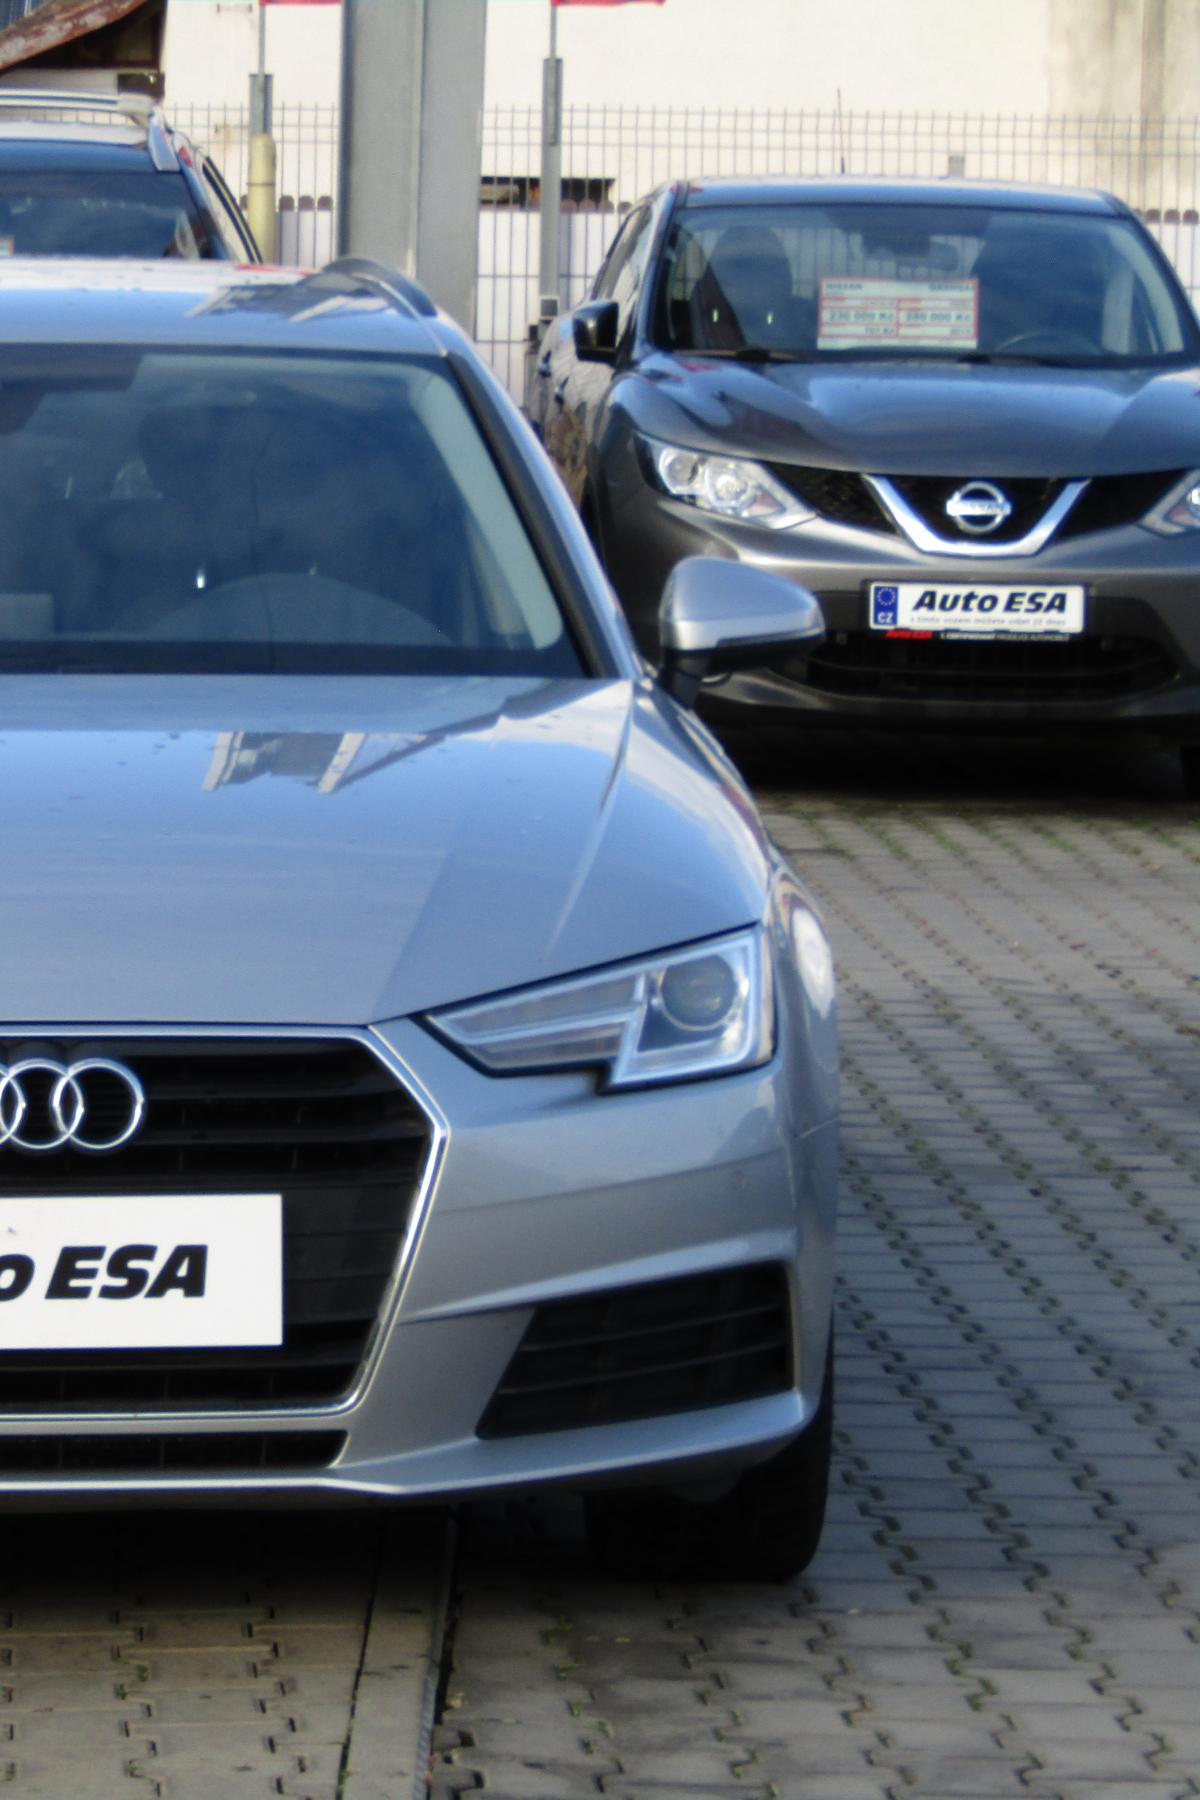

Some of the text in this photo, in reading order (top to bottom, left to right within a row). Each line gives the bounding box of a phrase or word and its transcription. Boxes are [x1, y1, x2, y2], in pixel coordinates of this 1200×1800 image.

[912, 590, 1067, 613] Auto ESA
[877, 612, 893, 623] CZ
[44, 1244, 208, 1300] ESA
